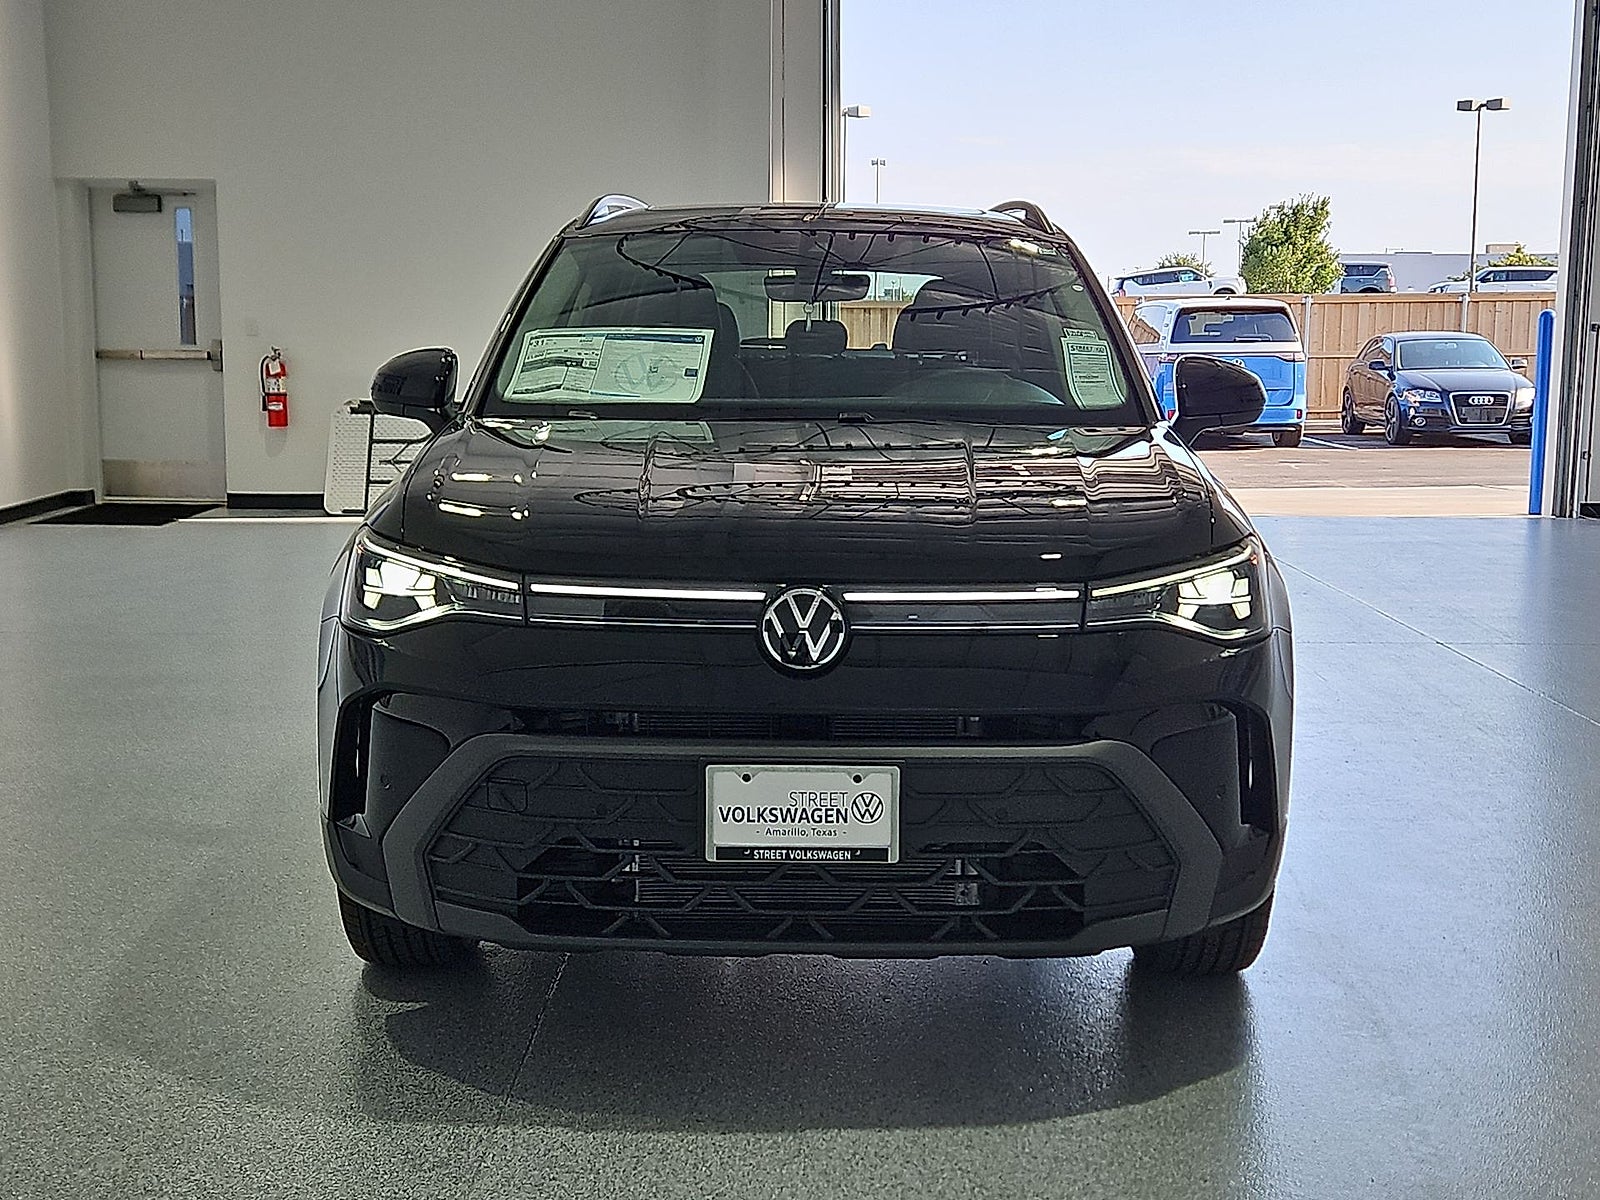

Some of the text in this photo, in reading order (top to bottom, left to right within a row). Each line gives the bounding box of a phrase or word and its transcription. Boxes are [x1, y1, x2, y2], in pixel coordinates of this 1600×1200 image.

[789, 791, 849, 807] STREET
[718, 806, 849, 824] VOLKSWAGEN
[765, 827, 838, 837] Amarillo, Texas
[753, 850, 851, 860] STREET VOLKSWAGEN
